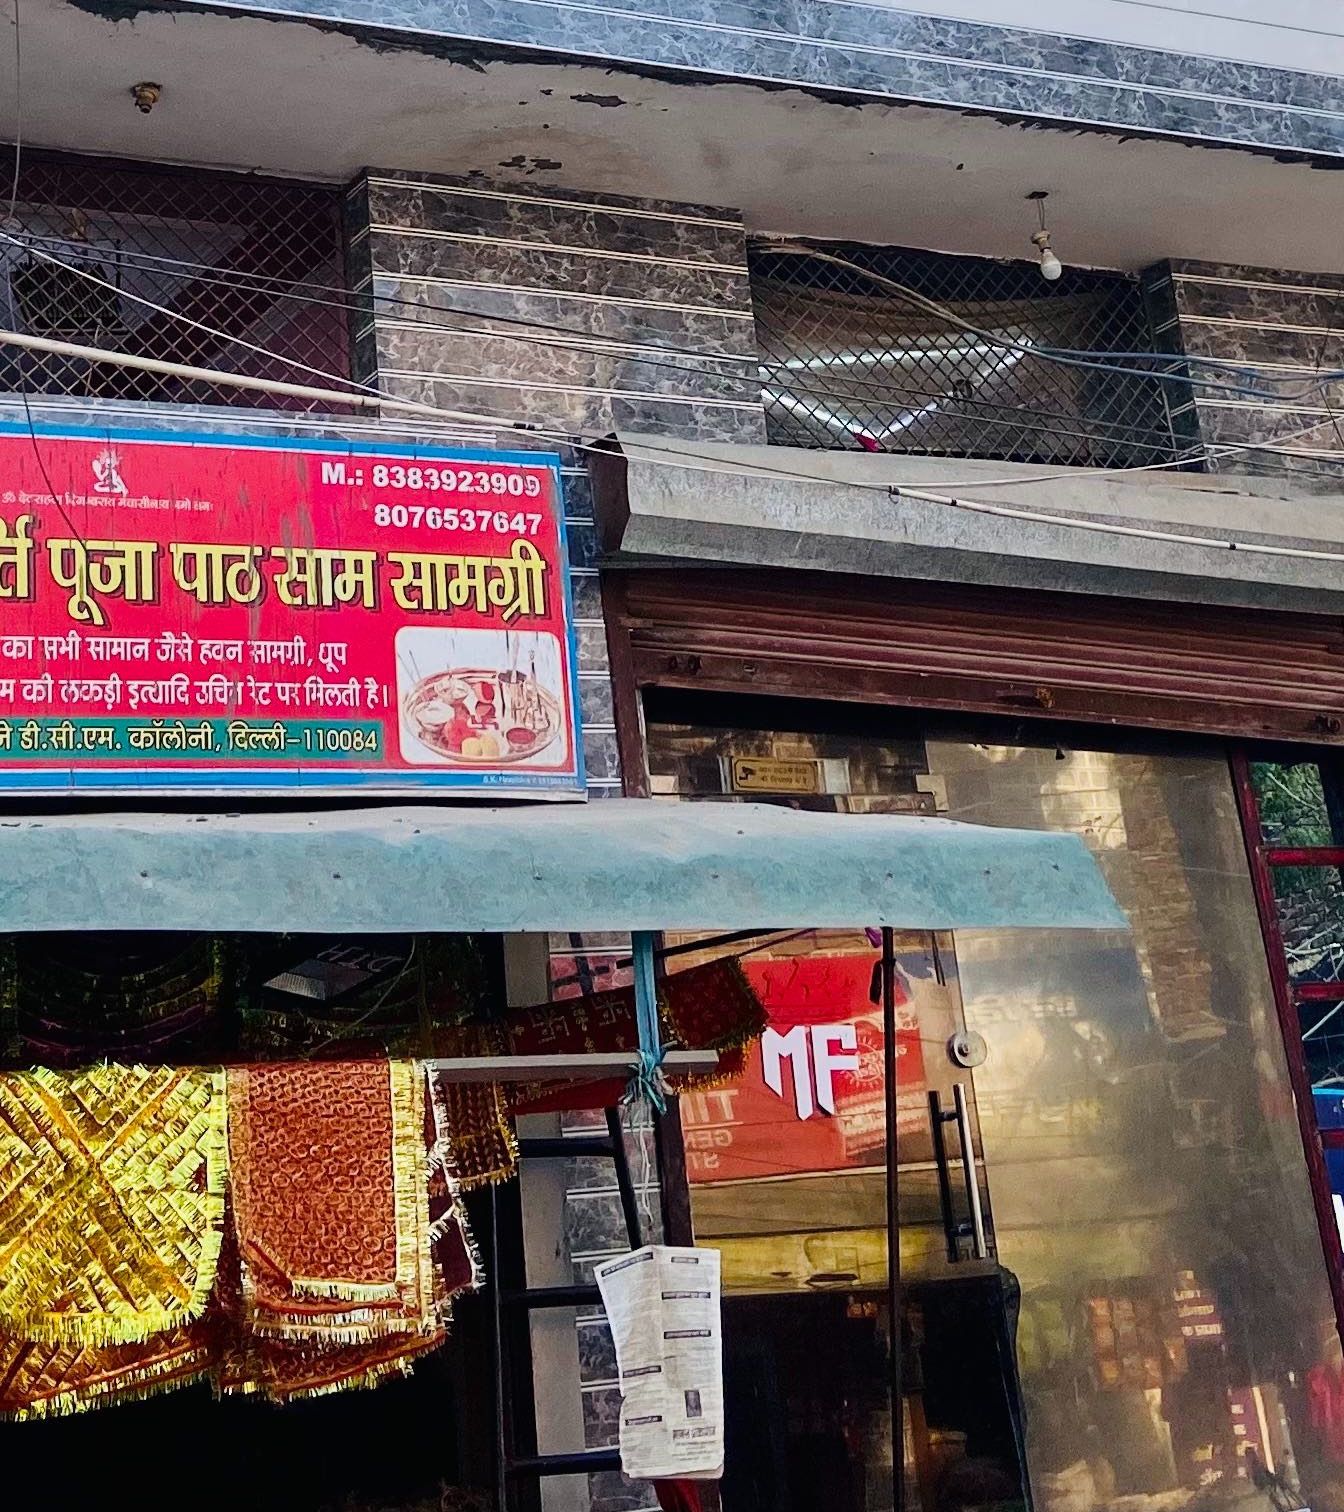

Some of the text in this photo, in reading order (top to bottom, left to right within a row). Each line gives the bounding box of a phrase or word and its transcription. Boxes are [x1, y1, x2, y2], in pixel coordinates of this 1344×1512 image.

[373, 464, 541, 498] 8383923909
[374, 504, 542, 535] 8076537647
[46, 538, 158, 626] पूजा
[169, 543, 262, 604] पाठ
[270, 548, 377, 610] साम
[387, 538, 547, 623] सामग्री
[0, 635, 35, 661] का
[38, 630, 81, 662] सभी
[86, 637, 150, 662] सामान
[154, 631, 194, 663] जैसे
[198, 639, 244, 664] हवन
[318, 641, 348, 673] धूप
[20, 673, 54, 704] की
[58, 672, 123, 710] लकड़ी
[126, 673, 190, 710] इत्यादि
[247, 675, 273, 706] रेट
[275, 682, 301, 706] पर
[303, 675, 361, 707] मिलती
